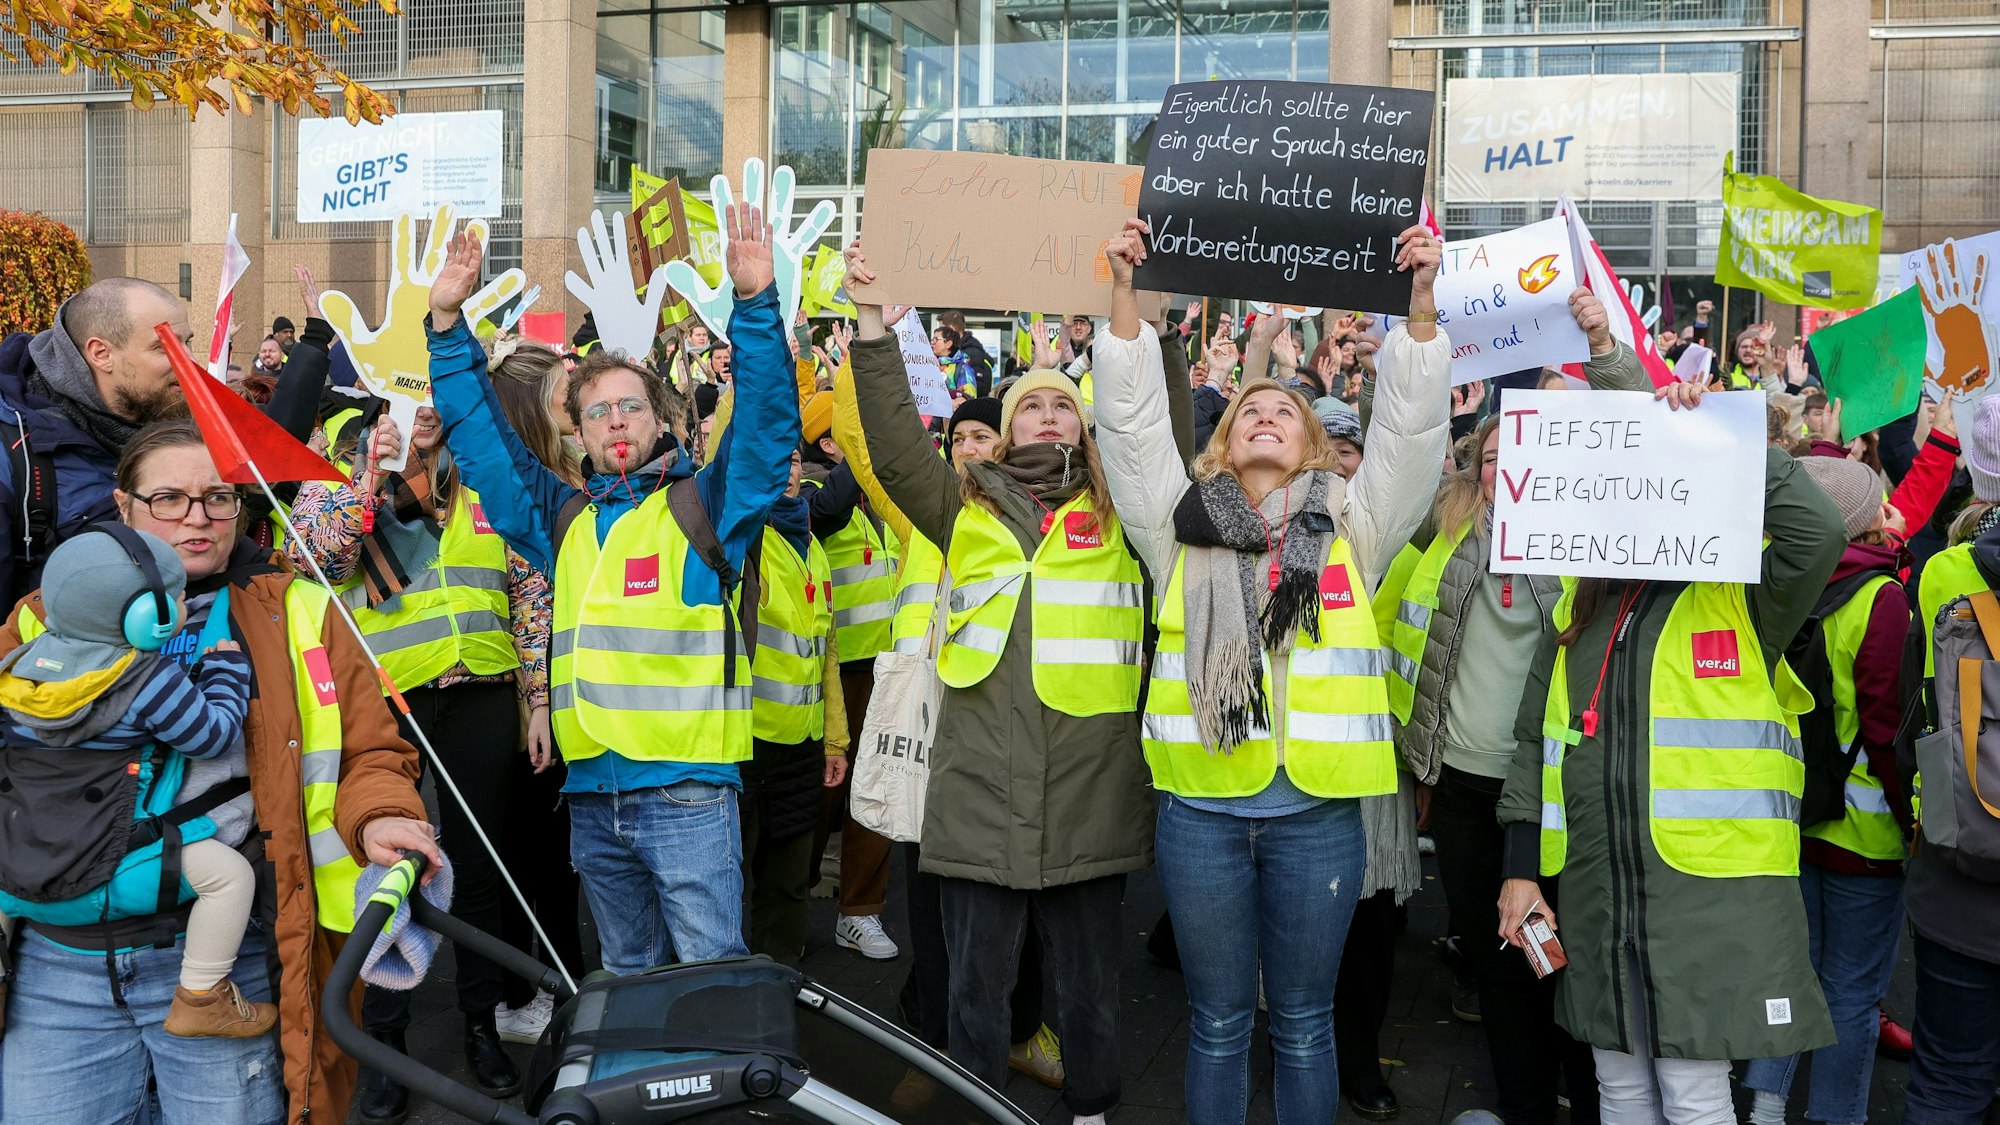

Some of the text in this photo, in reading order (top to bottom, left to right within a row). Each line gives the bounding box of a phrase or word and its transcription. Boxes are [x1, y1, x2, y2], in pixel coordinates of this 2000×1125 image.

[1168, 85, 1412, 126] Eigentlich sollte hier
[1460, 88, 1676, 144] ZUSAMMEN,
[310, 134, 371, 167] GEHT
[1158, 124, 1426, 167] ein guter Spruch stehen
[1484, 136, 1574, 174] HALT
[322, 180, 391, 212] NICHT
[900, 154, 1116, 204] Lohn RAUF
[1151, 166, 1414, 218] aber ich hatte keine
[1729, 206, 1870, 246] MEINSAM
[894, 220, 983, 276] Kita
[1030, 234, 1092, 278] AUF
[1147, 214, 1376, 282] Vorbereitungszeit
[1437, 244, 1489, 276] ITA
[1464, 283, 1507, 316] in &
[1804, 287, 1831, 296] ver.di
[1452, 318, 1542, 360] urn out !
[394, 376, 428, 392] MACHT
[1500, 468, 1689, 506] VERGÜTUNG
[1068, 534, 1099, 544] ver.di
[1500, 521, 1721, 567] LEBENSLANG
[627, 578, 658, 589] ver.di
[1322, 590, 1351, 602] ver.di
[1696, 658, 1736, 670] ver.di
[646, 1074, 712, 1100] THULE
